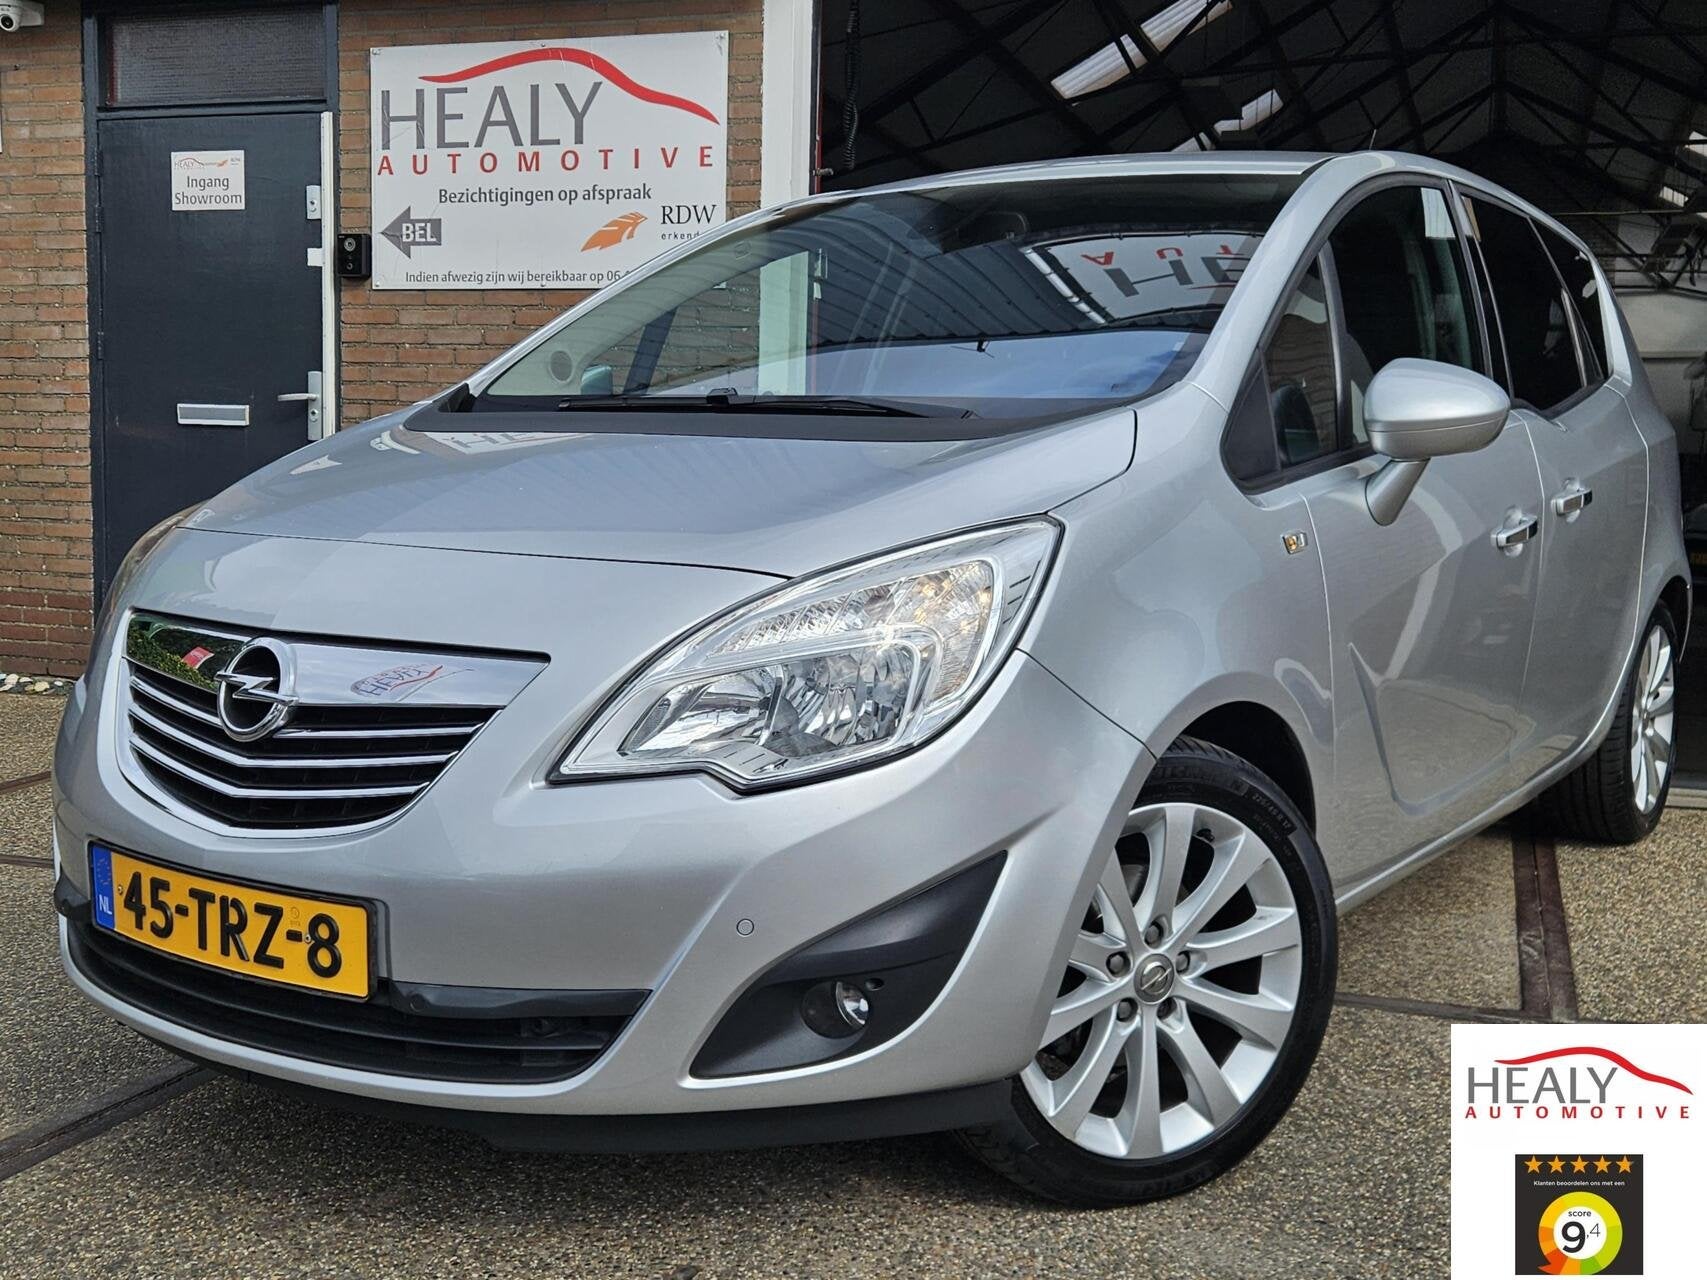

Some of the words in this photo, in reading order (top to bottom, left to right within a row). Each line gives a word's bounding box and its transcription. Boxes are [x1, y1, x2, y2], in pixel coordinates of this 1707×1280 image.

[381, 81, 603, 151] HEALY
[377, 145, 713, 177] AUTOMOTIVE
[186, 175, 230, 191] Ingang
[174, 191, 243, 206] Showroom
[438, 187, 554, 207] Bezichtigingen
[557, 190, 579, 206] op
[582, 183, 652, 205] afspraak
[660, 204, 717, 225] RDW
[401, 223, 436, 243] BEL
[405, 271, 439, 282] Indien
[441, 270, 484, 285] afwezig
[485, 271, 506, 285] zijn
[507, 270, 525, 285] wij
[526, 269, 588, 282] bereikbaar
[589, 272, 605, 285] op
[98, 893, 113, 915] NL
[123, 871, 342, 978] 45-TRZ-8
